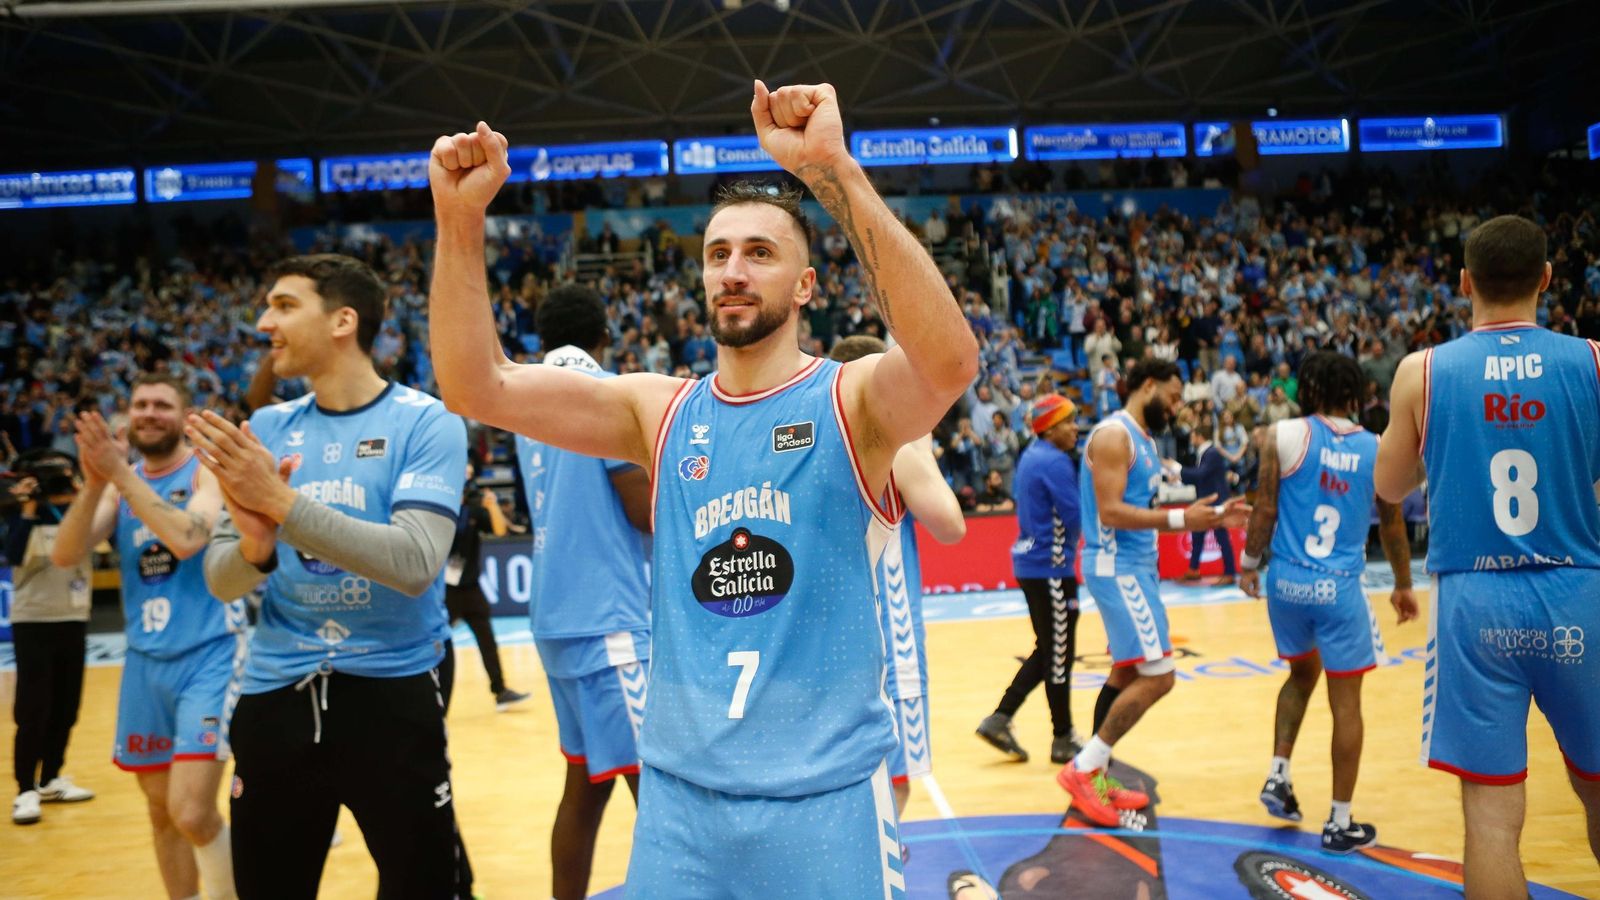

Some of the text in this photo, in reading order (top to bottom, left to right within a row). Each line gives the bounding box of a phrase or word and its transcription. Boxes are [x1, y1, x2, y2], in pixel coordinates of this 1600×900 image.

[861, 135, 988, 157] Estrella Galicia
[1484, 353, 1543, 380] APIC
[1483, 393, 1546, 422] Río
[777, 433, 793, 442] liga
[778, 437, 811, 449] endesa
[1490, 449, 1539, 536] 8
[695, 480, 791, 539] BREOGÁN
[1304, 504, 1340, 559] 3
[709, 551, 776, 576] Estrella
[711, 572, 774, 597] Galicia
[142, 597, 171, 633] 19
[733, 595, 753, 614] 0,0
[1498, 635, 1547, 650] LUGO
[727, 650, 760, 719] 7
[127, 733, 171, 753] Río
